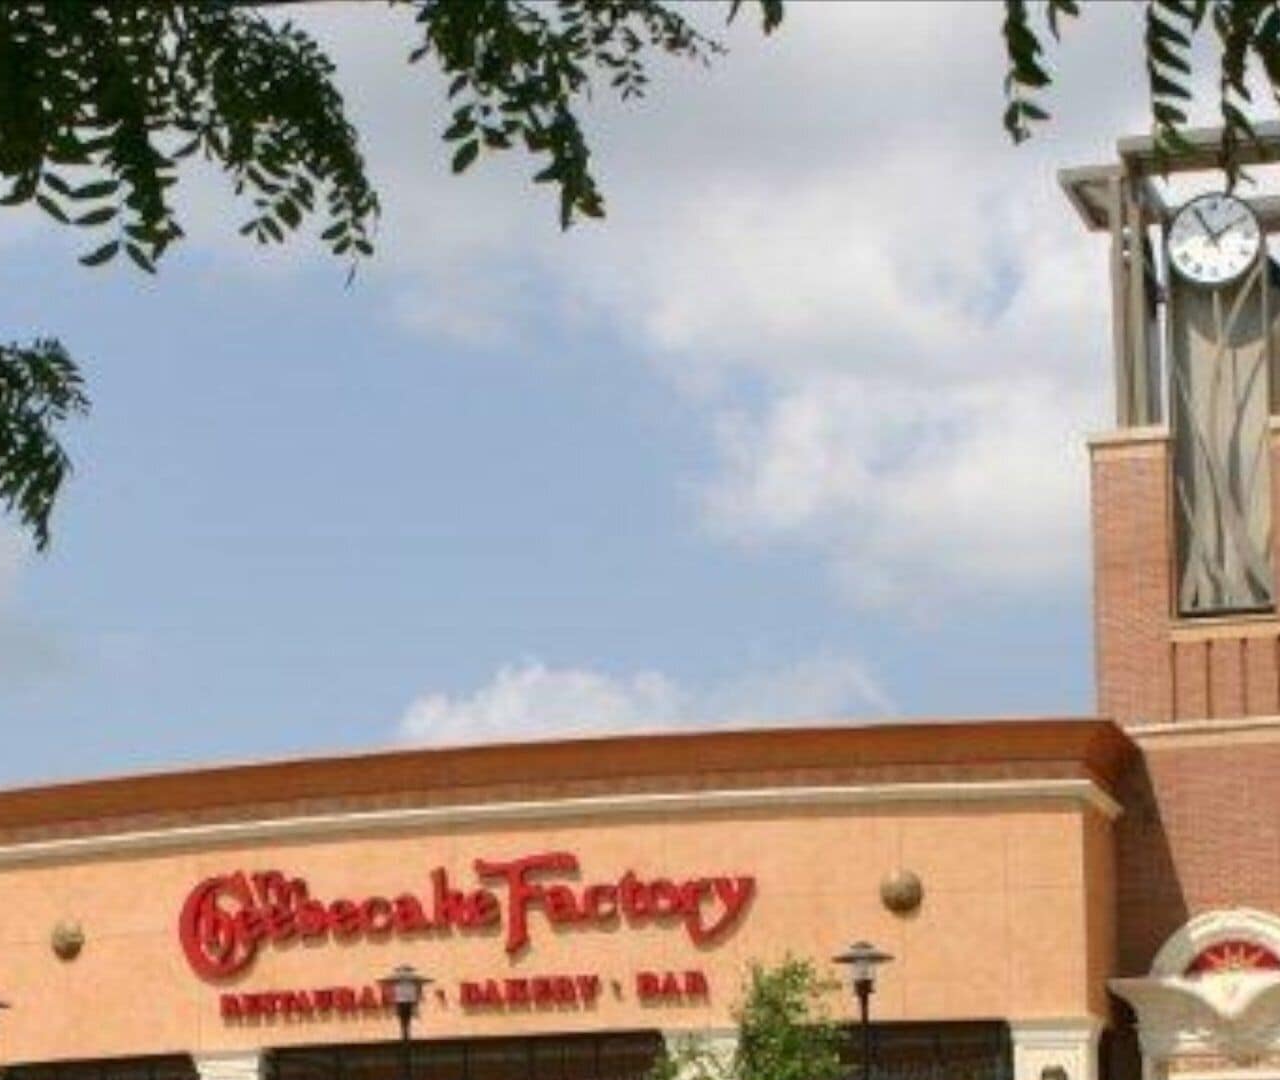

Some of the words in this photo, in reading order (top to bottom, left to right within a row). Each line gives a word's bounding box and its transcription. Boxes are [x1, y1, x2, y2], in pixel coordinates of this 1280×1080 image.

[179, 866, 502, 986] Cheesecake
[474, 852, 756, 954] Factory
[220, 985, 412, 1018] RESTAURAN
[459, 974, 600, 1006] BAKERY
[636, 970, 709, 998] BAR
